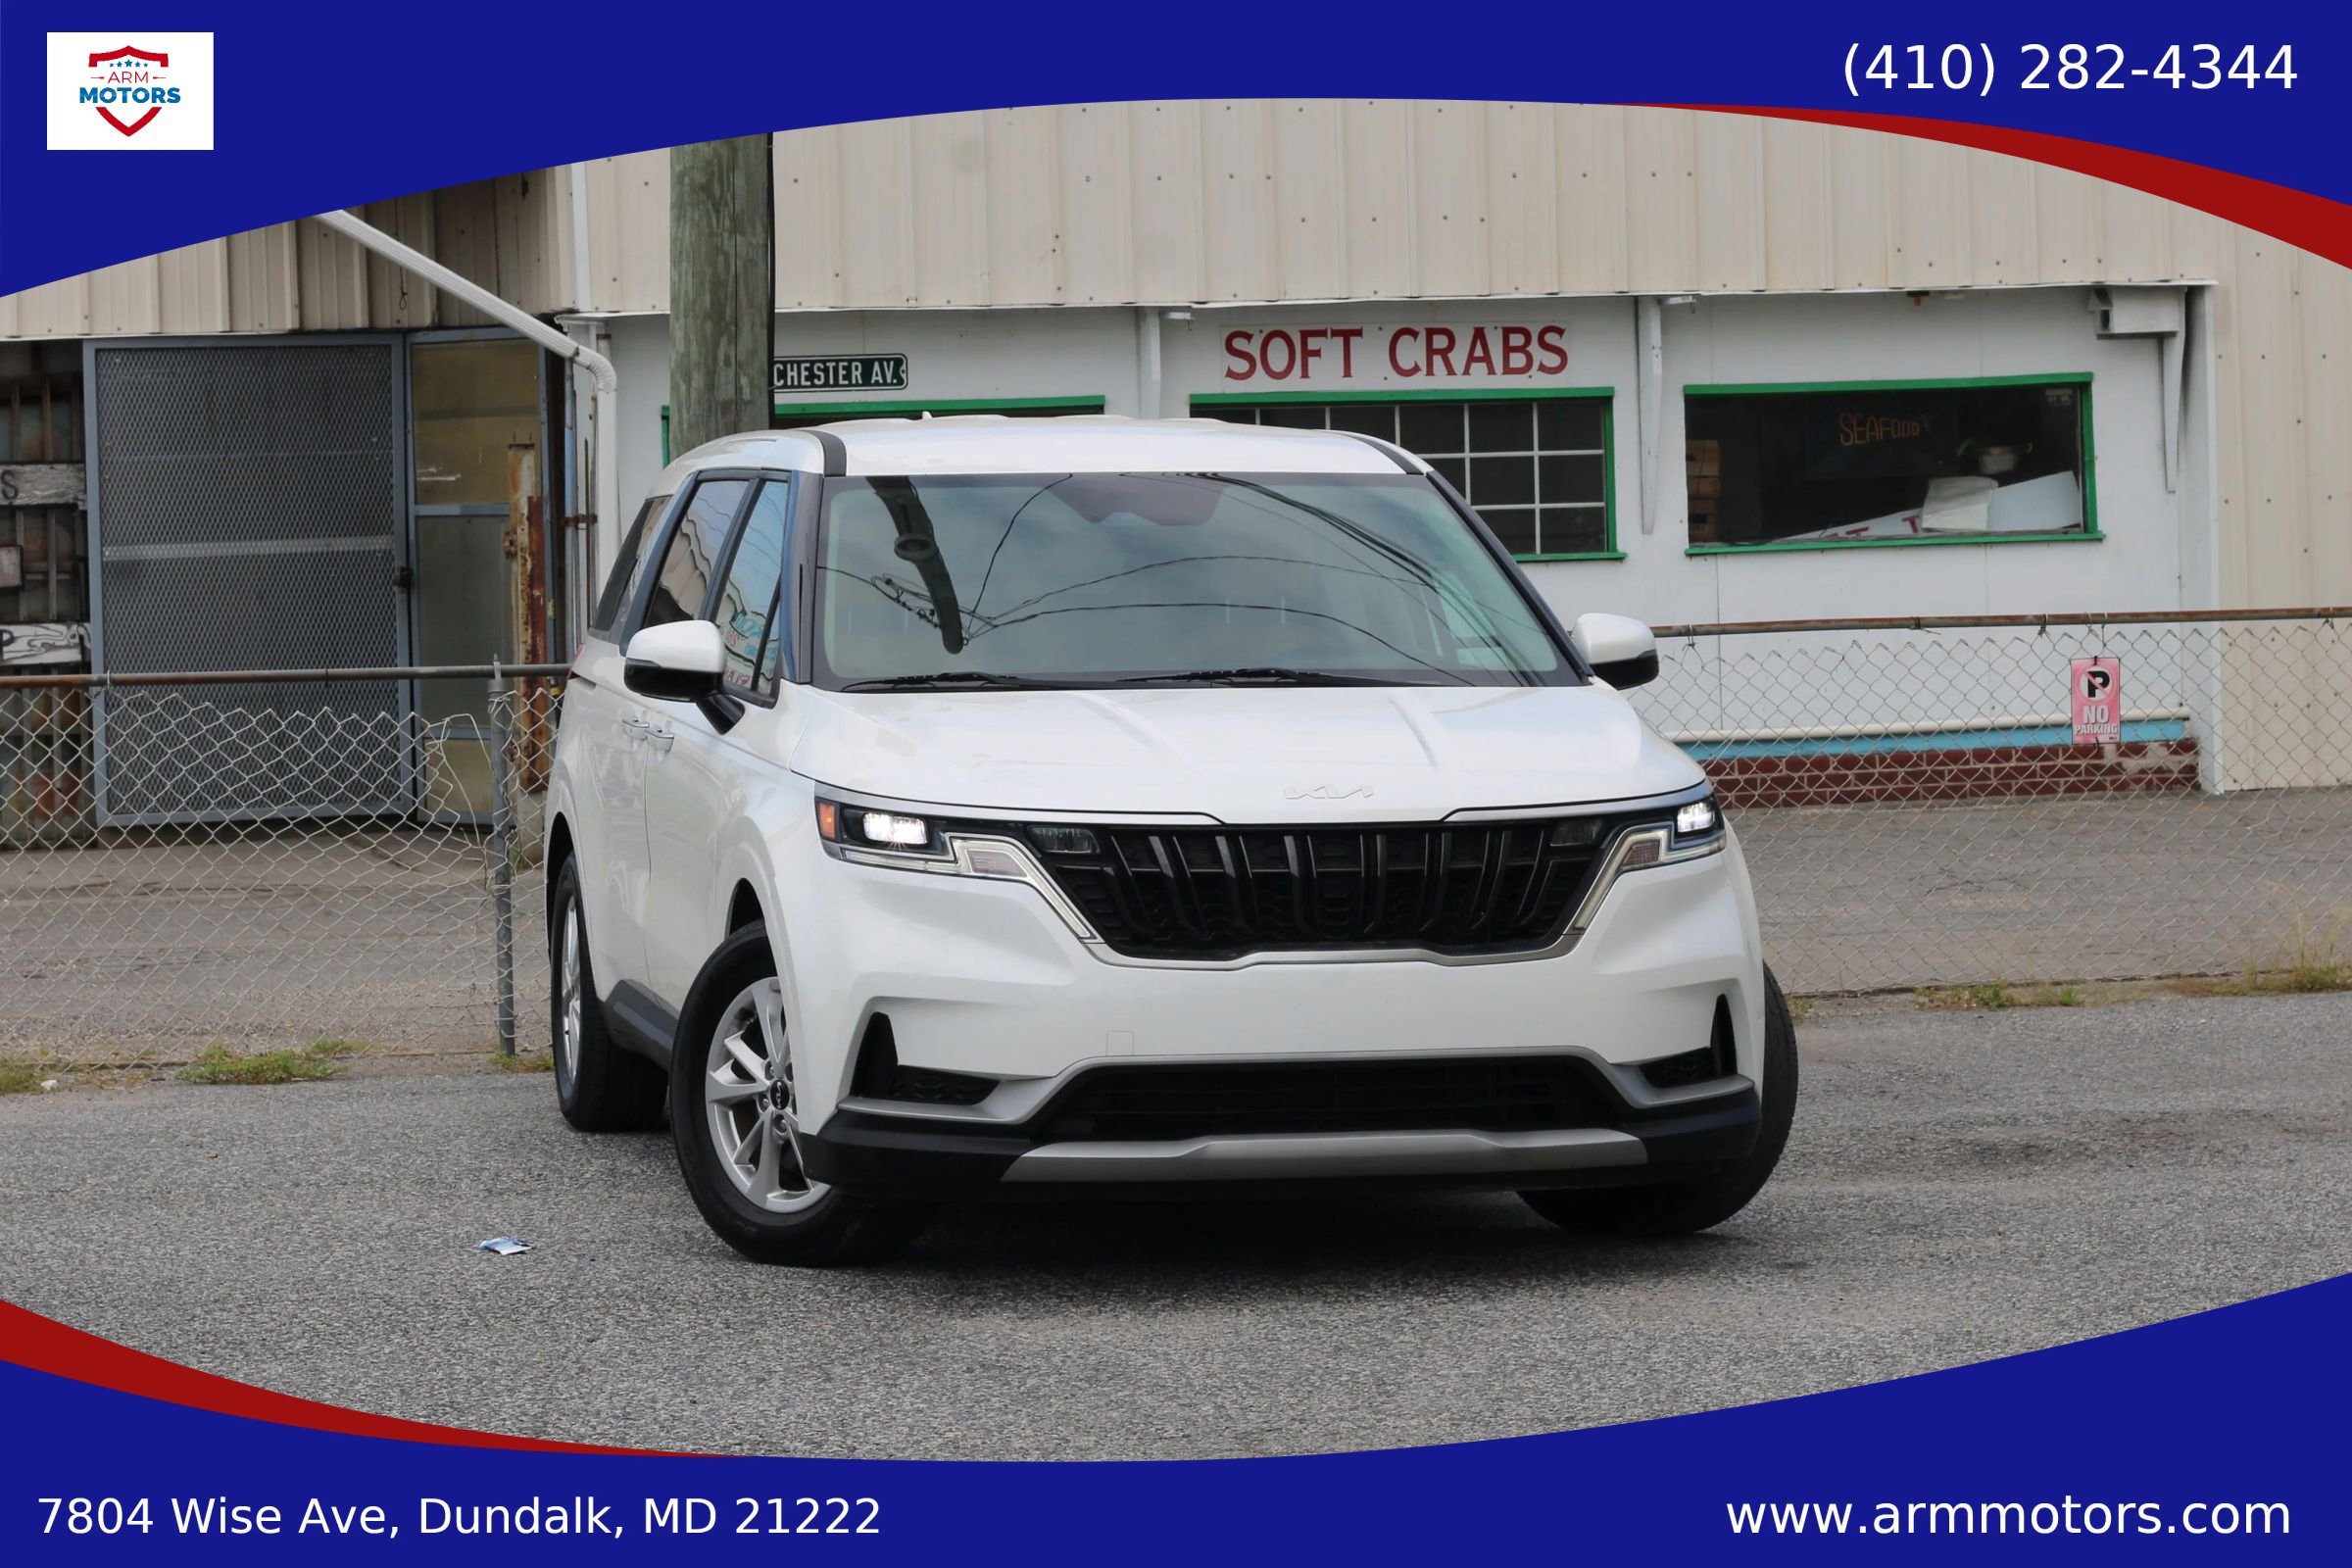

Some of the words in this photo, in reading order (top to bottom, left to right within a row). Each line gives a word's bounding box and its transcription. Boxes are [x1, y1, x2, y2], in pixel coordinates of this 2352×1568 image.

[1224, 326, 1363, 380] SOFT
[1388, 325, 1569, 377] CRABS
[870, 361, 898, 384] AV.
[1839, 411, 1921, 447] SEAFOOD
[2083, 705, 2110, 724] NO
[2076, 723, 2118, 735] PARKING
